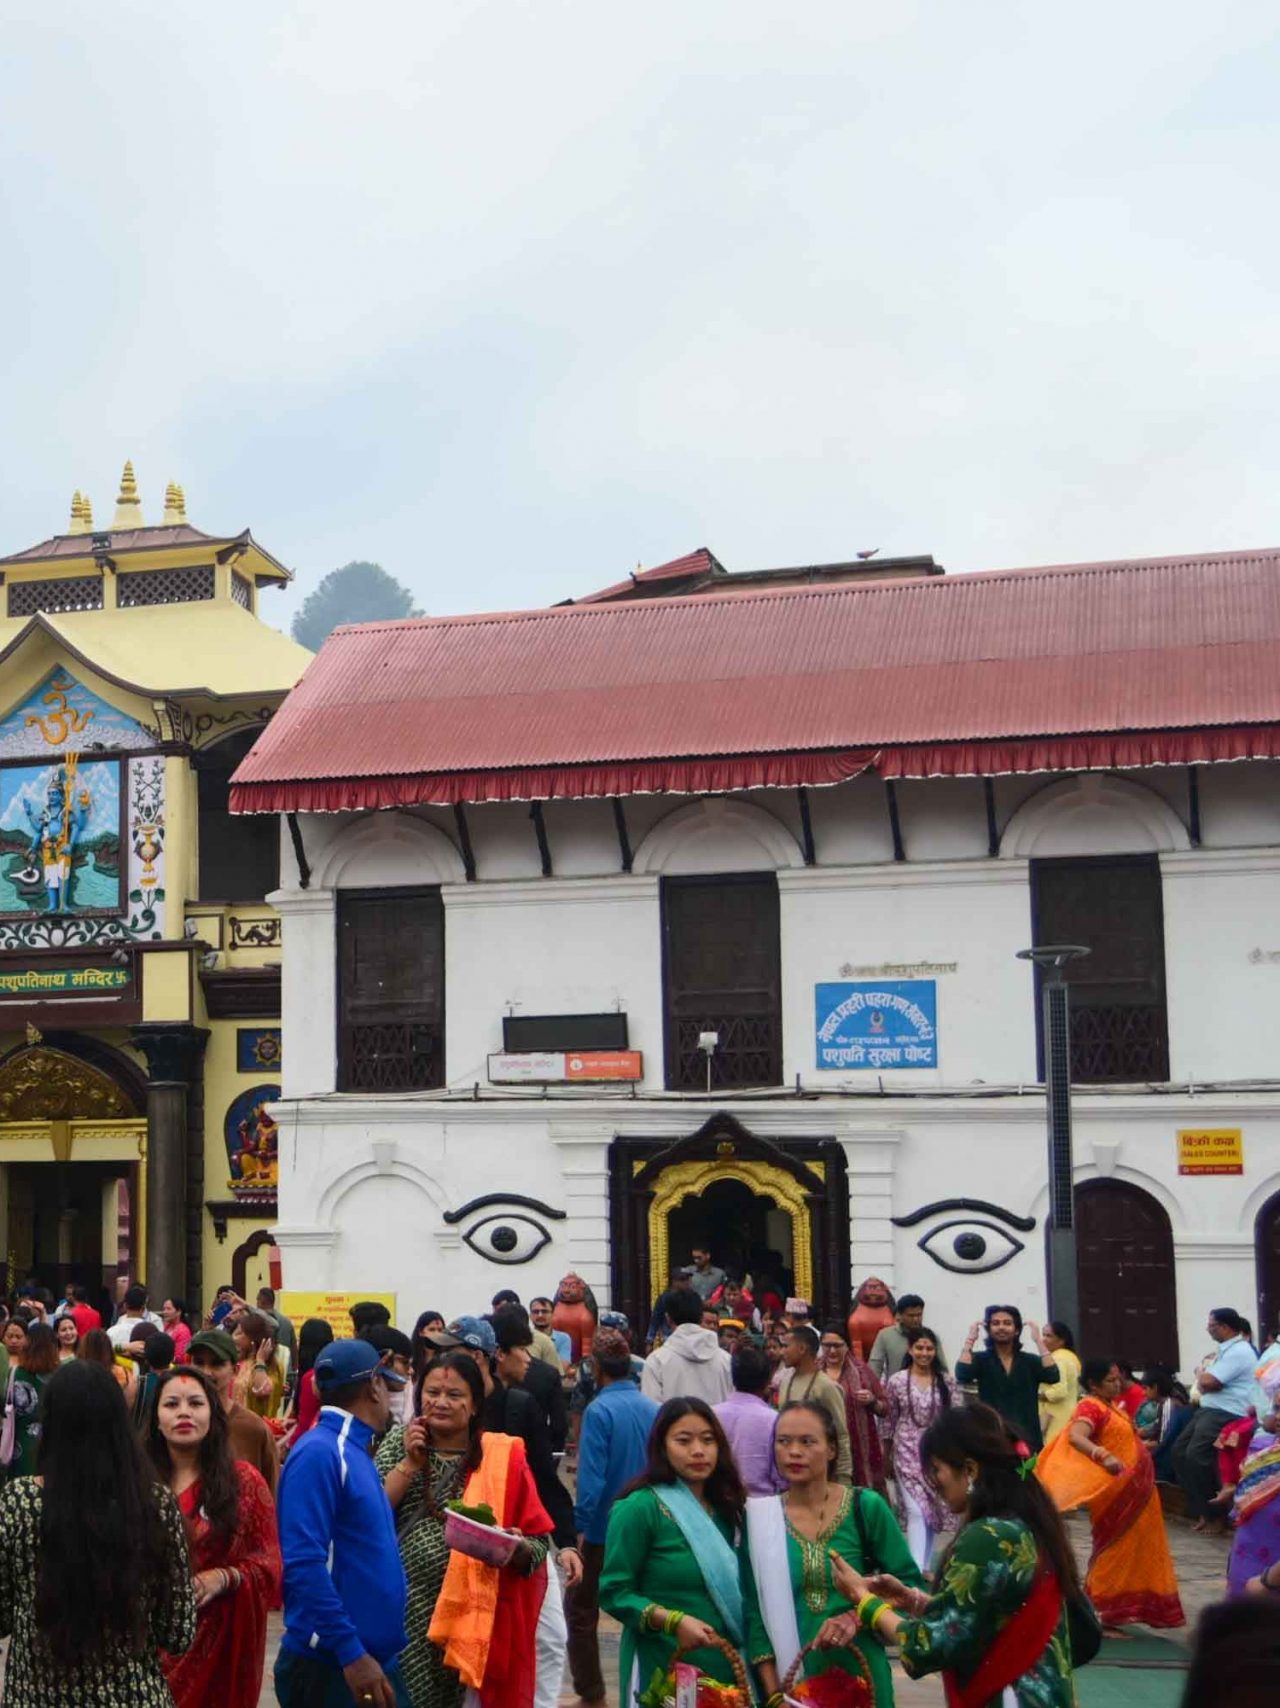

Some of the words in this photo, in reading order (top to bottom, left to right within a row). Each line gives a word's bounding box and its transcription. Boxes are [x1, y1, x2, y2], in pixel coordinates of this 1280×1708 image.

[71, 968, 114, 986] मन्दिर
[822, 1045, 865, 1066] पशुपति
[868, 1048, 901, 1066] सुरक्षा
